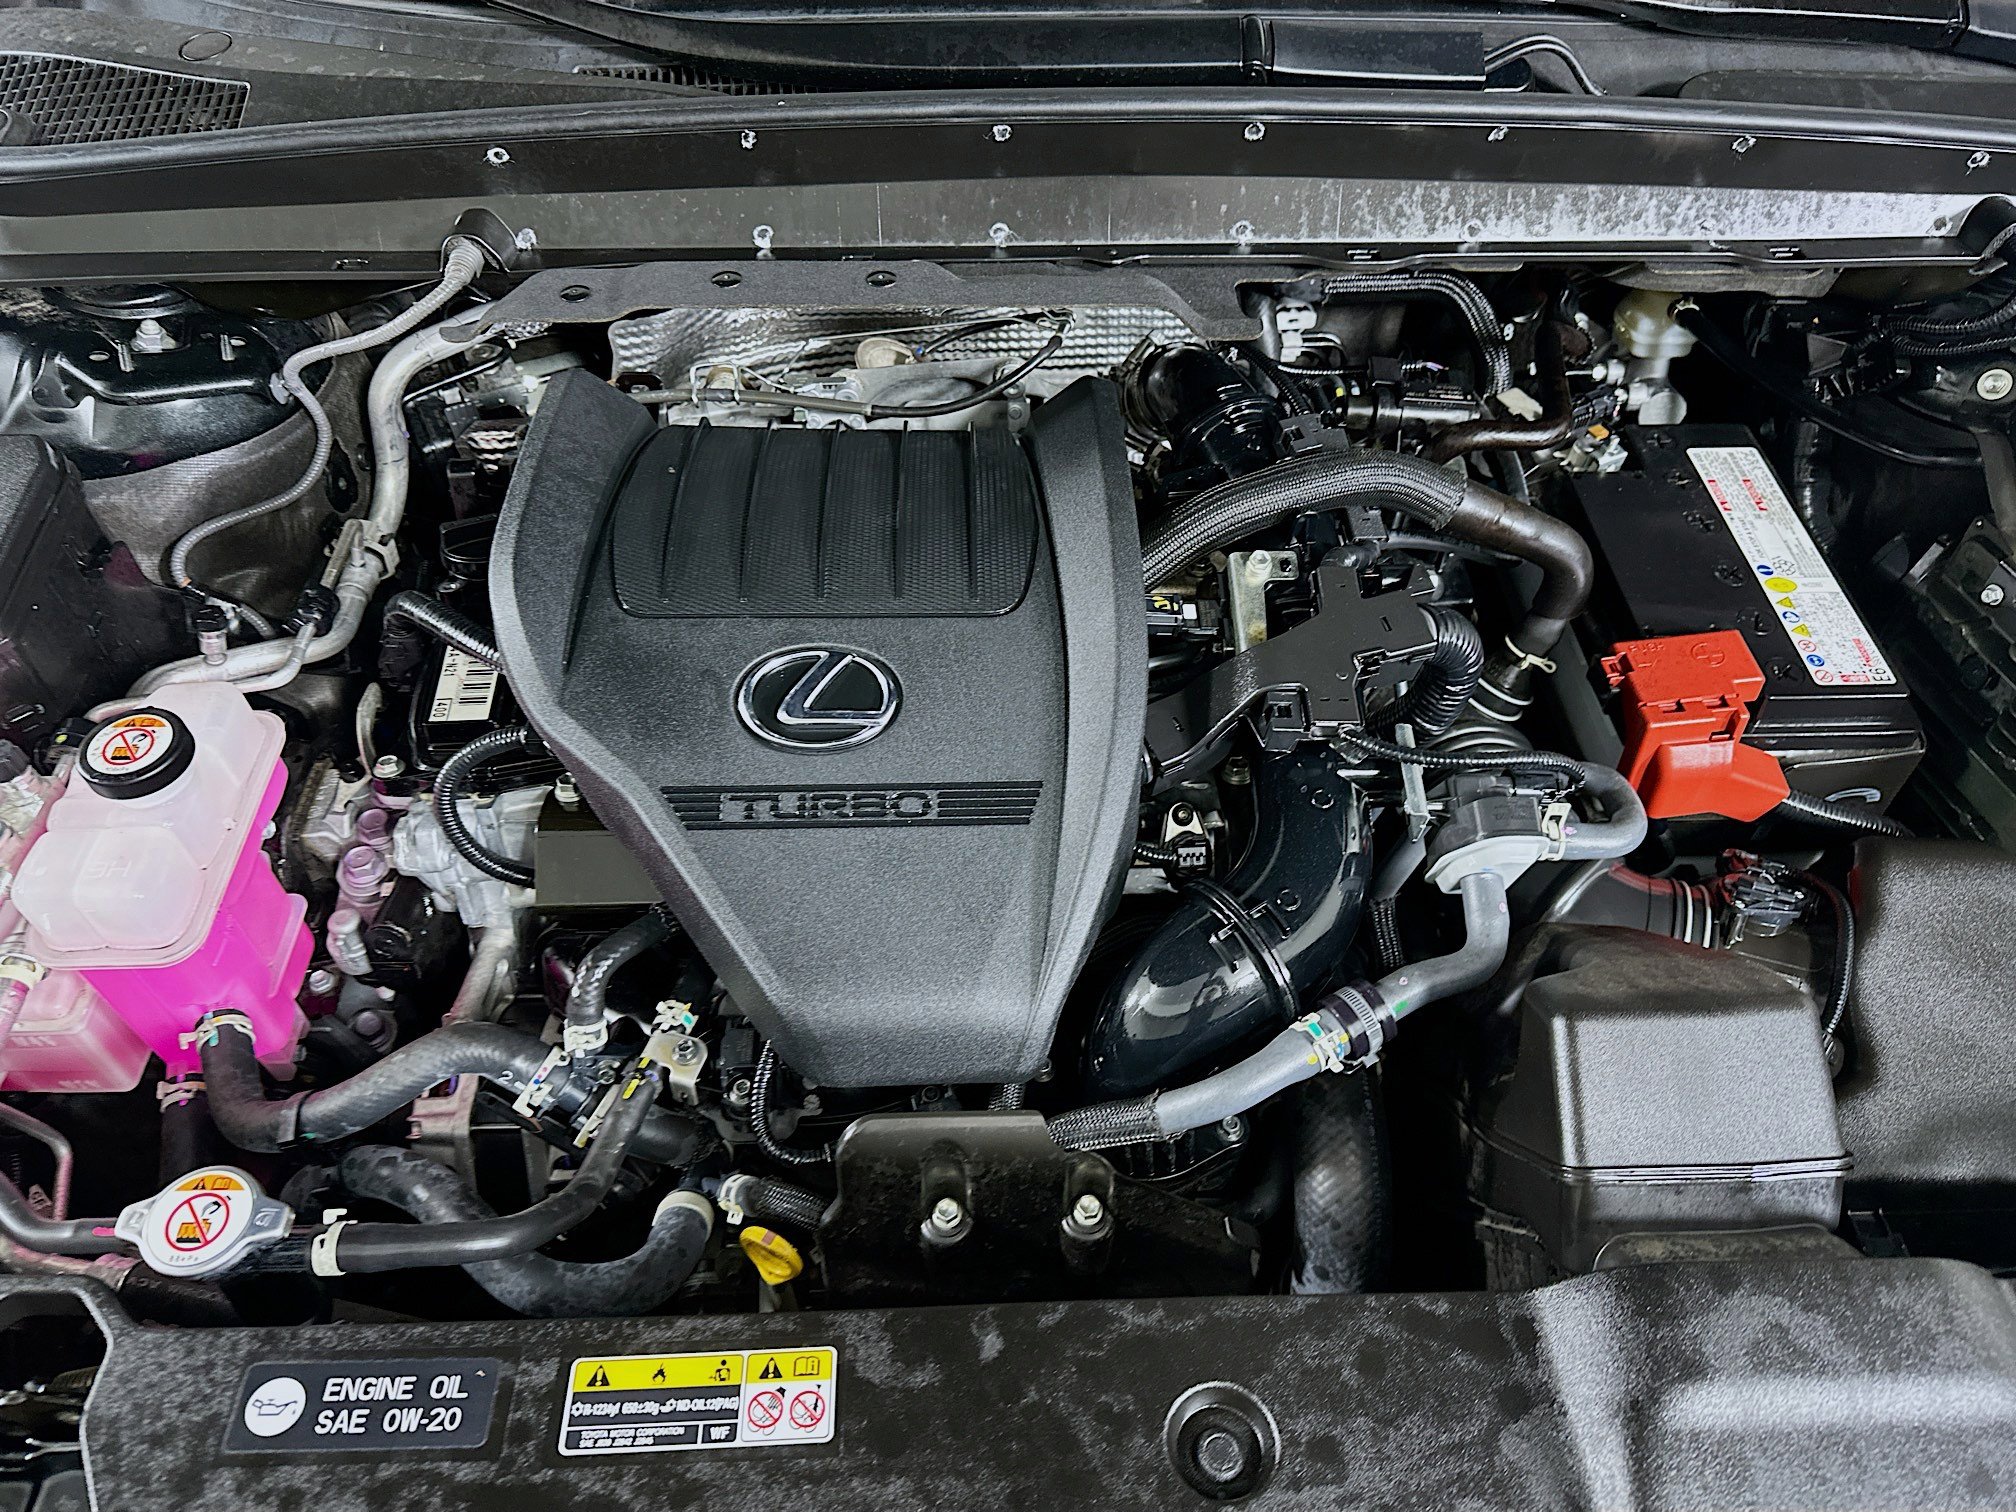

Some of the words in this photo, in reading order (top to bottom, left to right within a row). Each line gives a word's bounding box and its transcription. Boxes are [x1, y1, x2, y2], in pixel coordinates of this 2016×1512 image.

[432, 702, 448, 718] 400
[728, 791, 932, 819] TURBO
[322, 1376, 417, 1401] ENGINE
[429, 1375, 469, 1399] OIL
[314, 1408, 370, 1434] SAE
[382, 1407, 463, 1433] 0W-20
